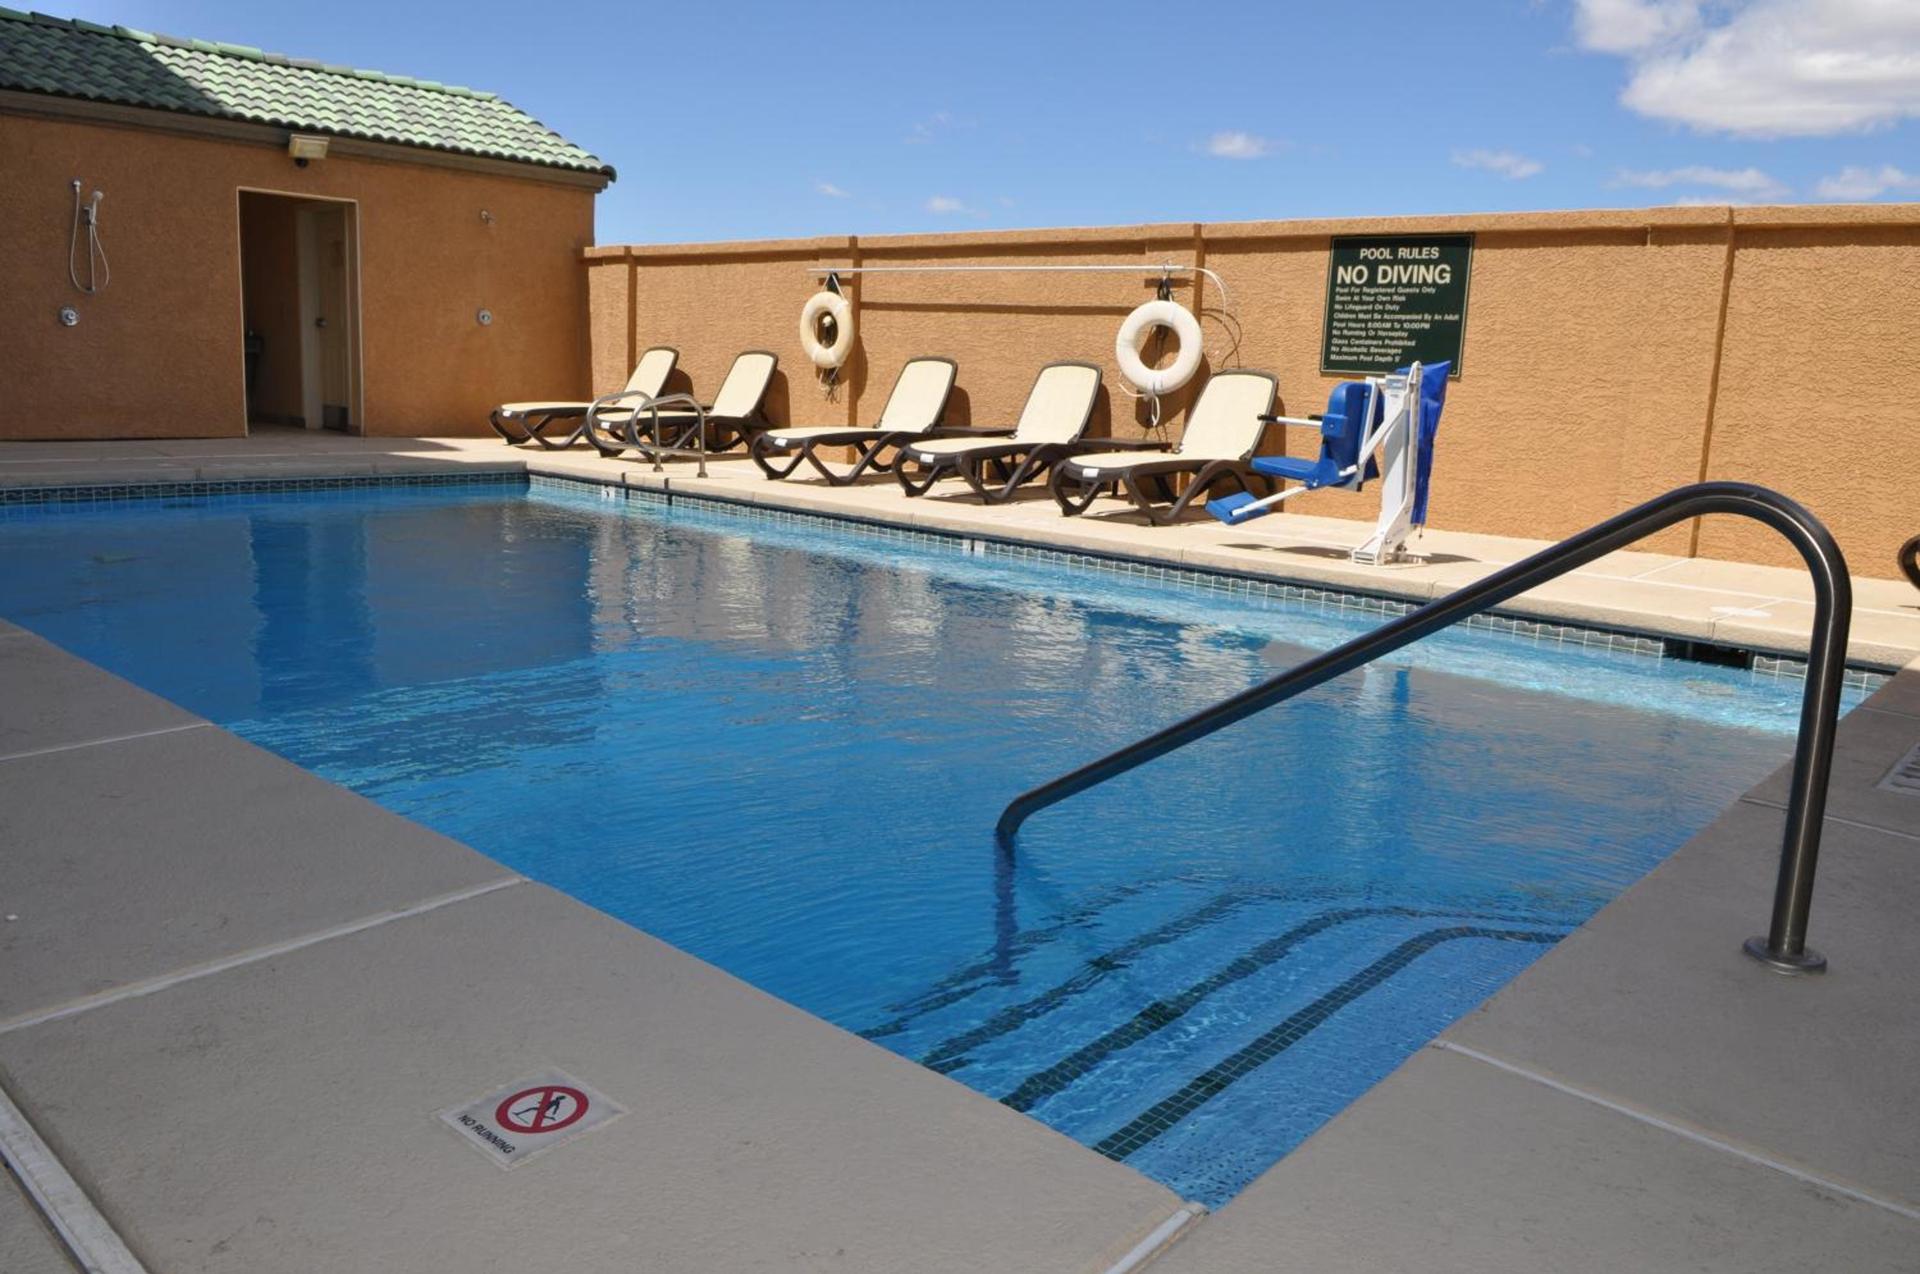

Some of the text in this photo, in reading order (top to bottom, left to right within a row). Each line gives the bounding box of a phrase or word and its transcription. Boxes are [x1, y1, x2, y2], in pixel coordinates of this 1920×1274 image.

[1360, 247, 1440, 260] POOL RULES
[1337, 264, 1451, 284] NO DIVING
[1362, 286, 1396, 294] Registered
[1421, 286, 1436, 294] Only
[1383, 313, 1422, 321] Accompanied
[1342, 329, 1366, 337] Running
[1377, 330, 1408, 338] Horseplay
[1384, 338, 1416, 346] Prohibited
[1370, 347, 1402, 355] Beverages
[457, 1114, 516, 1154] NO RUNNING
